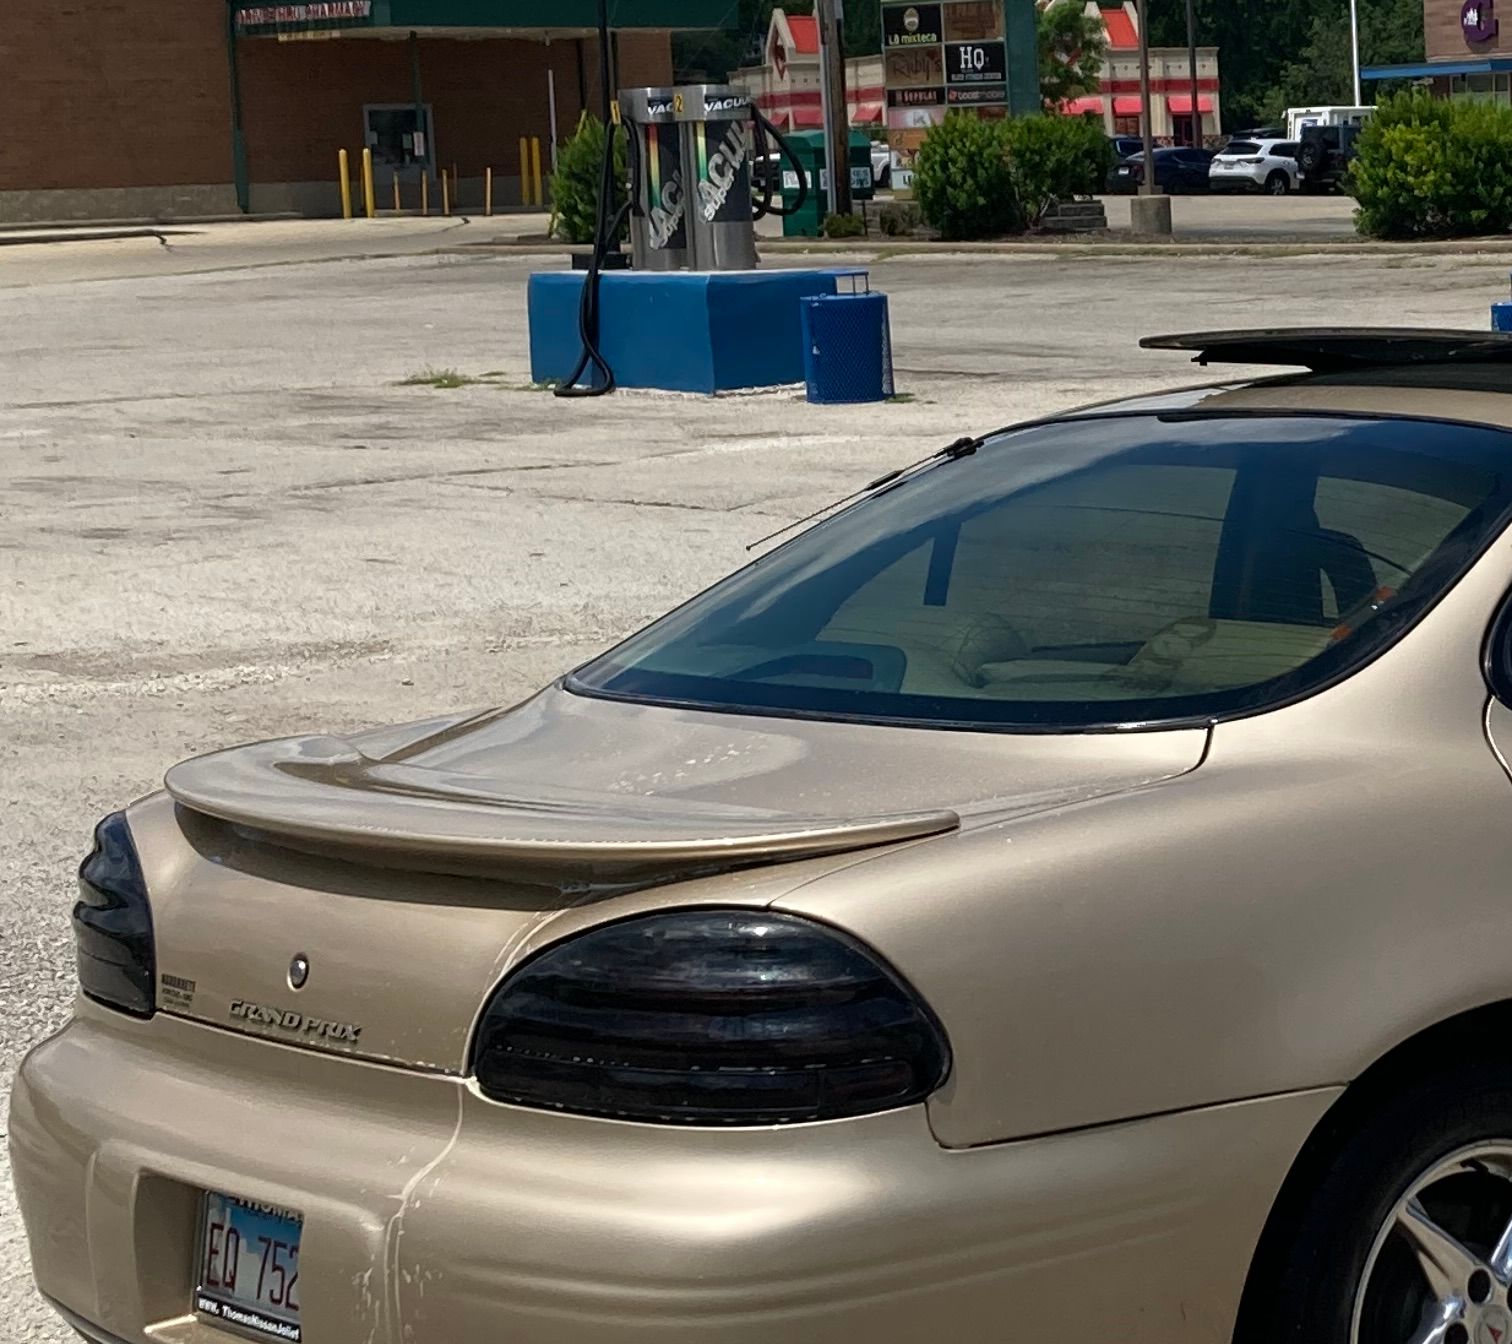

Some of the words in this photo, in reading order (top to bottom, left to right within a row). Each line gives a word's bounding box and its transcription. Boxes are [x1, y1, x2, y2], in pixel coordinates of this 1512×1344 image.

[959, 46, 985, 71] HQ
[676, 95, 683, 117] 2
[229, 999, 300, 1030] GRAND
[302, 1016, 361, 1042] PRIX
[206, 1222, 241, 1293] EQ
[256, 1235, 300, 1312] 752
